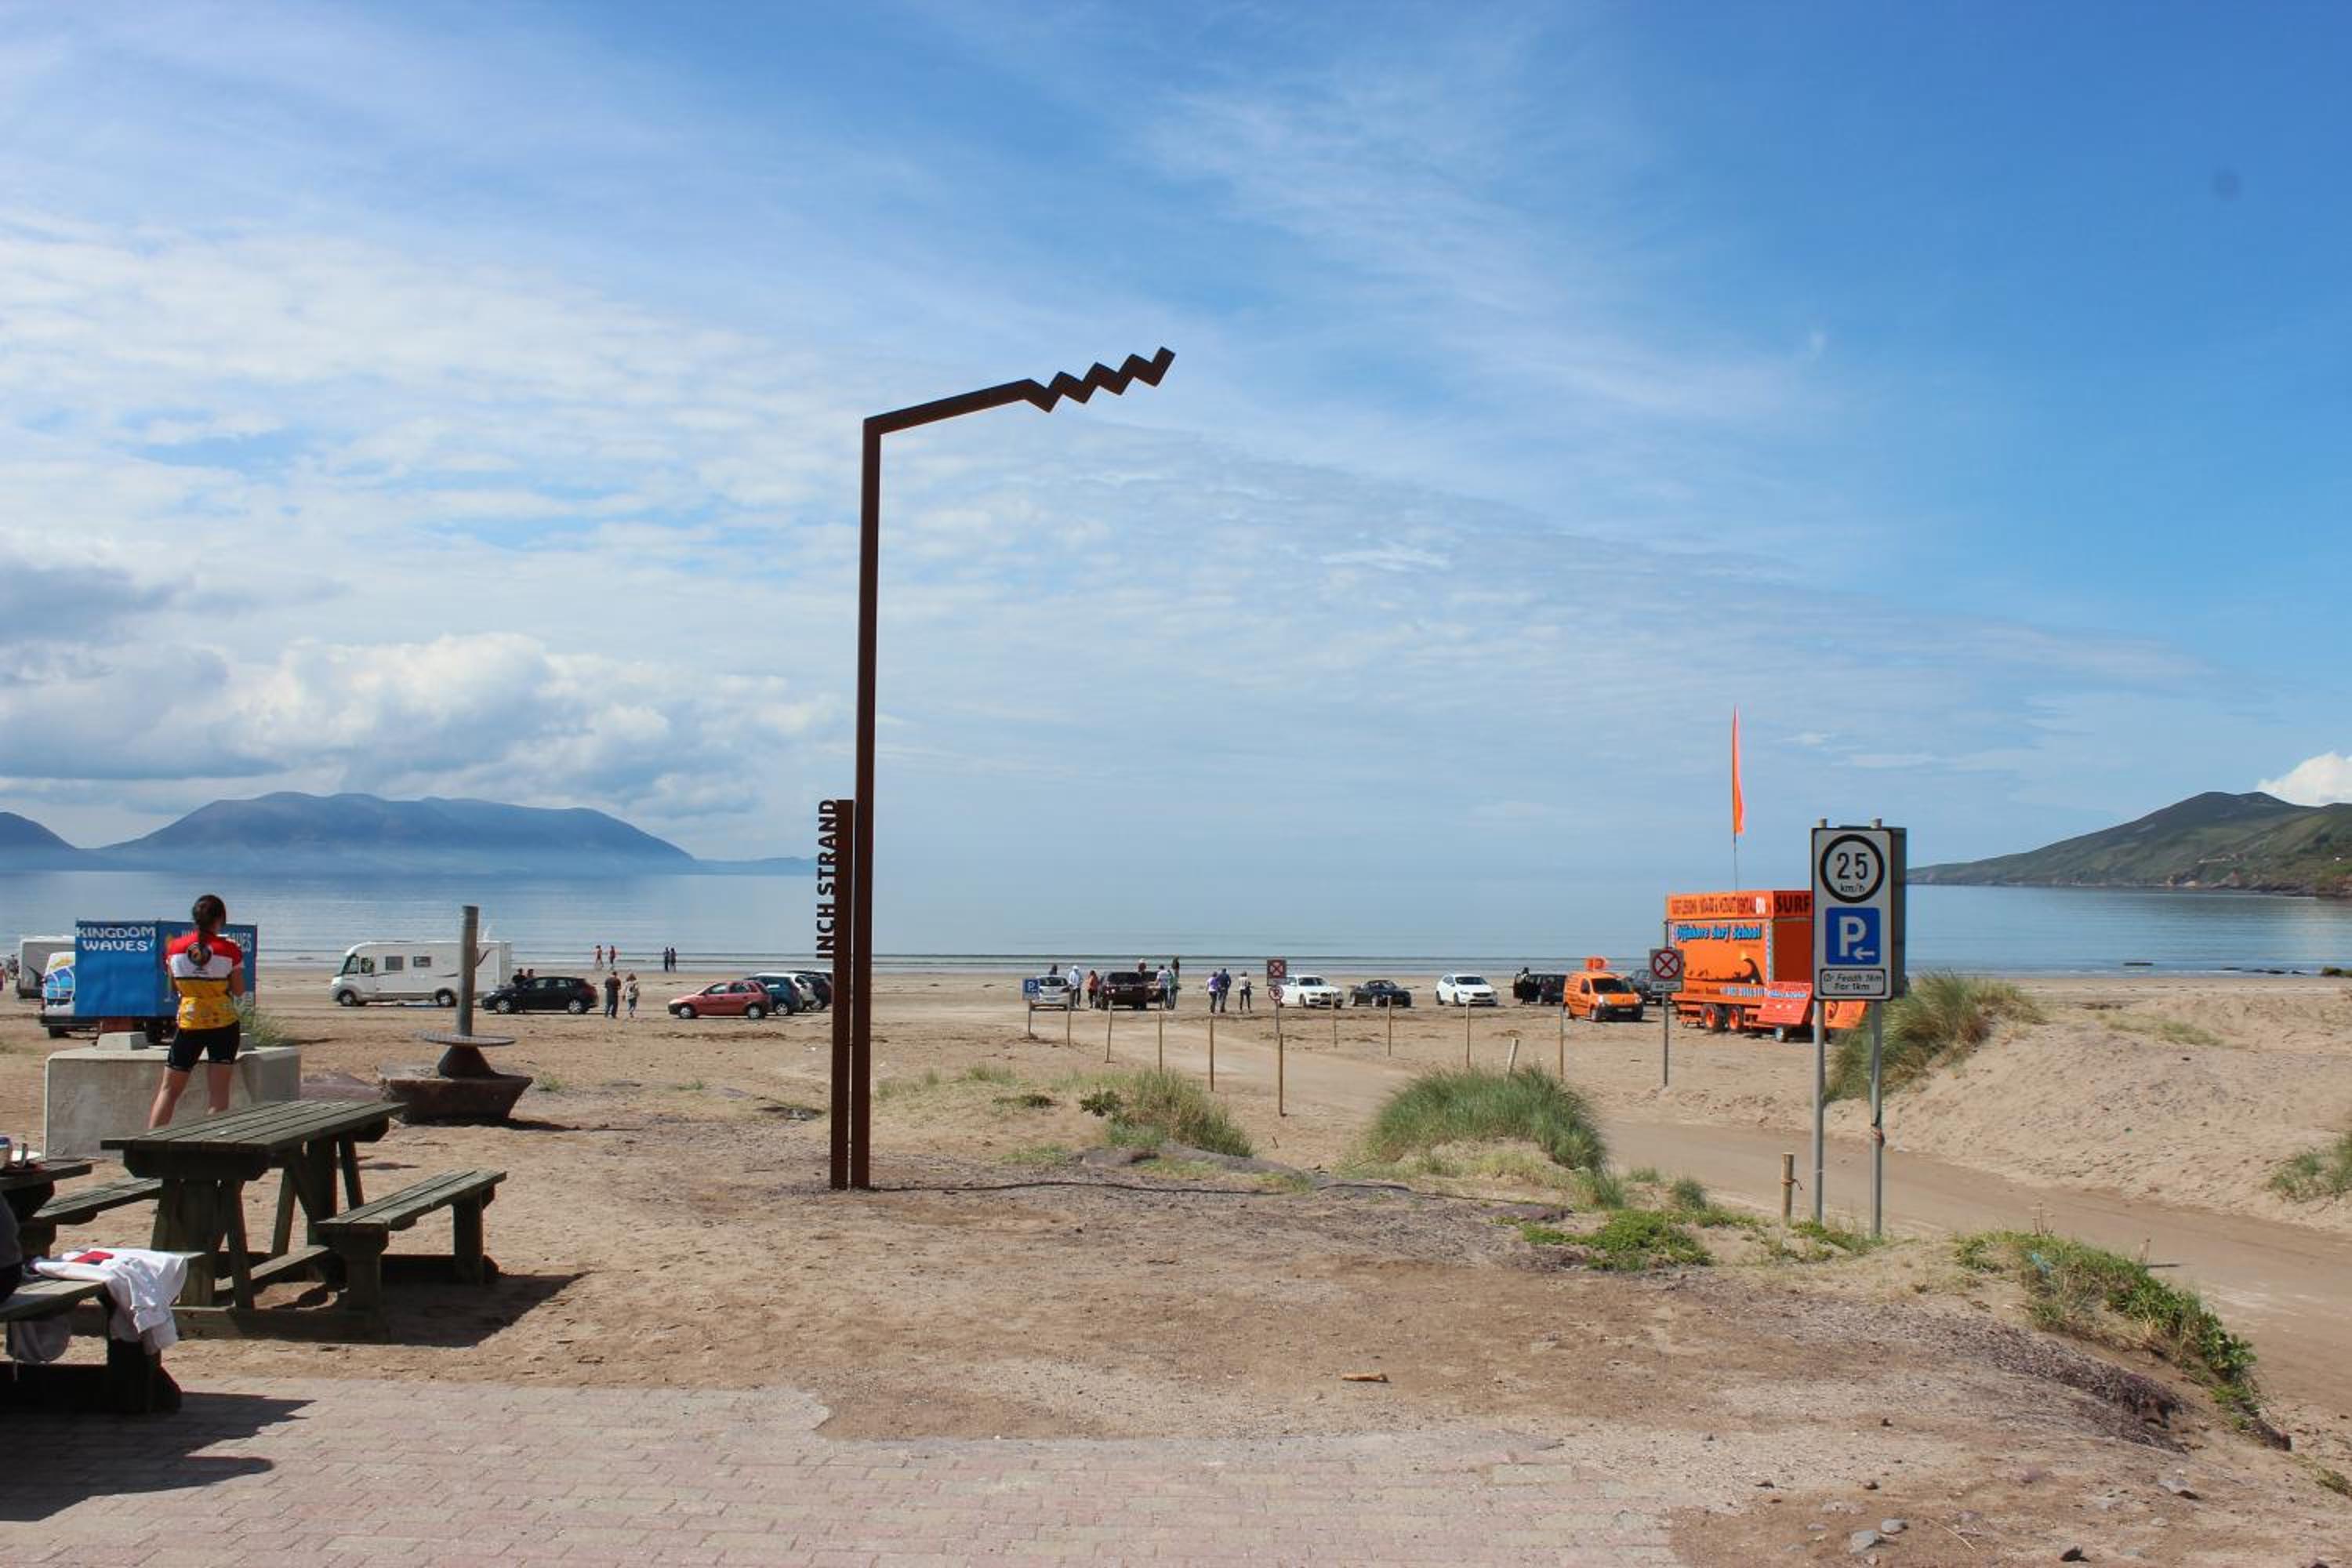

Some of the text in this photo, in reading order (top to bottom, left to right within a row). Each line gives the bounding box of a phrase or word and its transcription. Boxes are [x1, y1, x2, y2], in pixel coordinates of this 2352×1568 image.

[1837, 852, 1868, 880] 25
[816, 800, 837, 959] INCH STRAND
[1840, 883, 1866, 892] km/h
[1775, 895, 1810, 913] SURF
[75, 926, 156, 939] KINGDOM
[1838, 916, 1867, 957] P
[82, 940, 149, 952] WAVES
